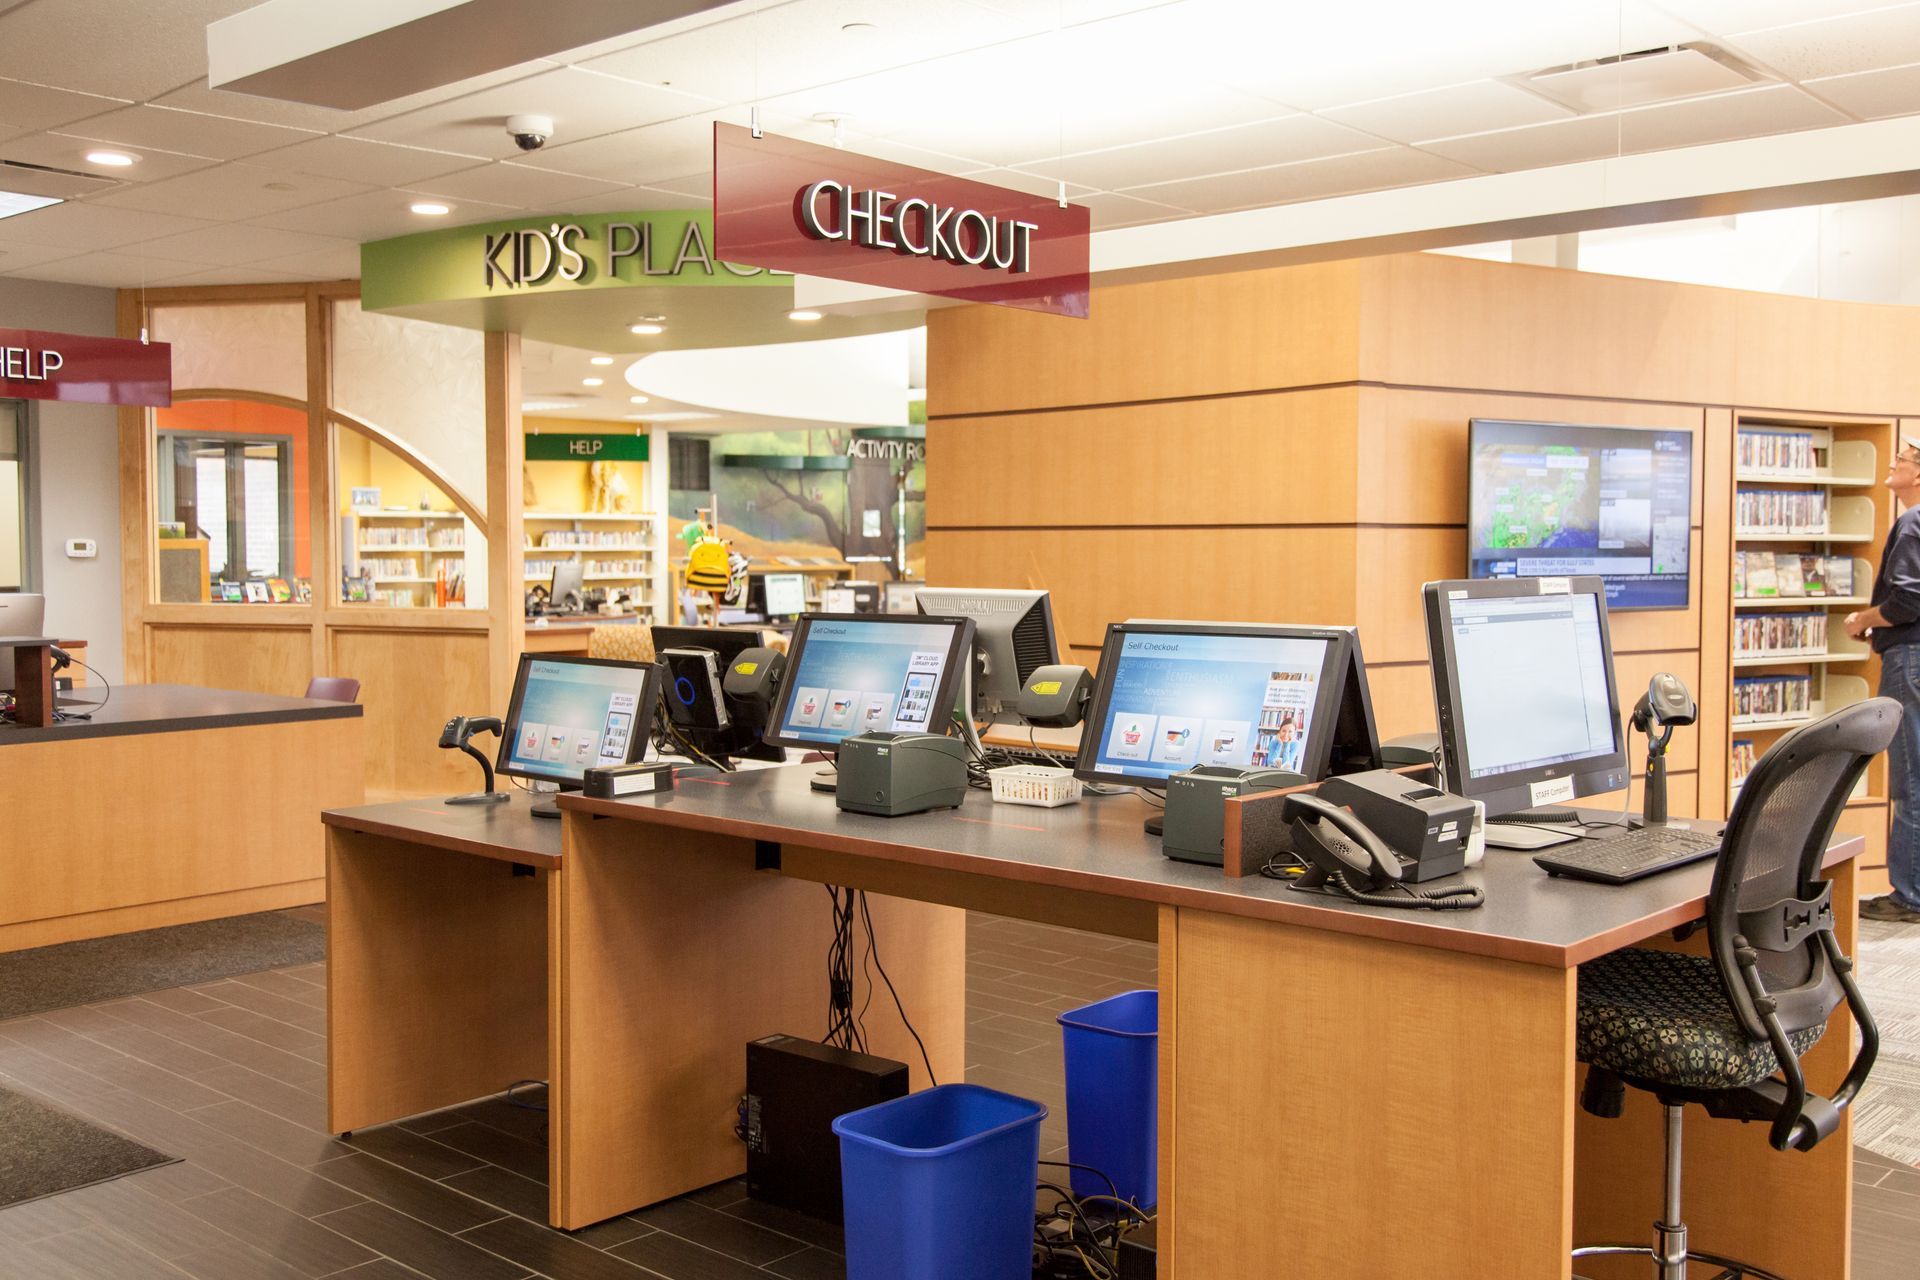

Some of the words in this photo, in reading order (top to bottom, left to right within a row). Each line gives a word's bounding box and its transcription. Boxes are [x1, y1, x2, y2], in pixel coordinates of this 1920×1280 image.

[804, 179, 1039, 273] CHECKOUT
[483, 222, 588, 290] KID'S
[607, 221, 795, 277] PLA
[569, 440, 603, 455] HELP
[846, 439, 904, 459] ACTIVITY
[1519, 559, 1537, 567] SEVERE
[1538, 559, 1556, 567] THREAT
[1557, 559, 1566, 567] FOR
[1579, 559, 1595, 567] STATES
[823, 627, 847, 635] Checkout
[1128, 641, 1142, 650] Self
[1143, 642, 1179, 652] Checkout
[1535, 789, 1550, 801] STAFF
[1550, 784, 1570, 798] Computer
